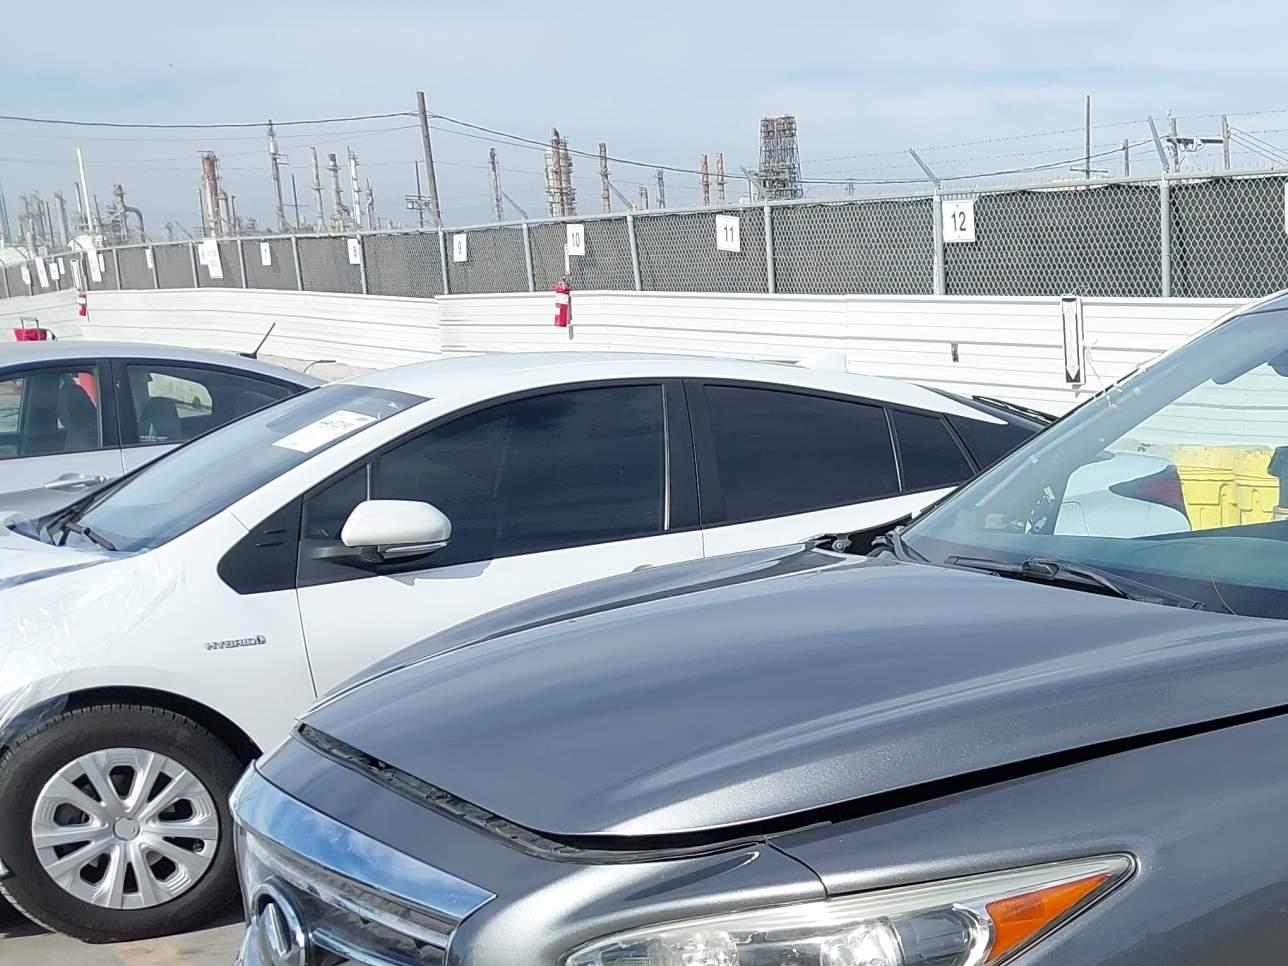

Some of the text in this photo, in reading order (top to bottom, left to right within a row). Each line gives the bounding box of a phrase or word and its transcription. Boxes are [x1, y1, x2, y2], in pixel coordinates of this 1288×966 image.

[951, 210, 966, 231] 12
[571, 231, 581, 248] 10
[723, 223, 734, 243] 11
